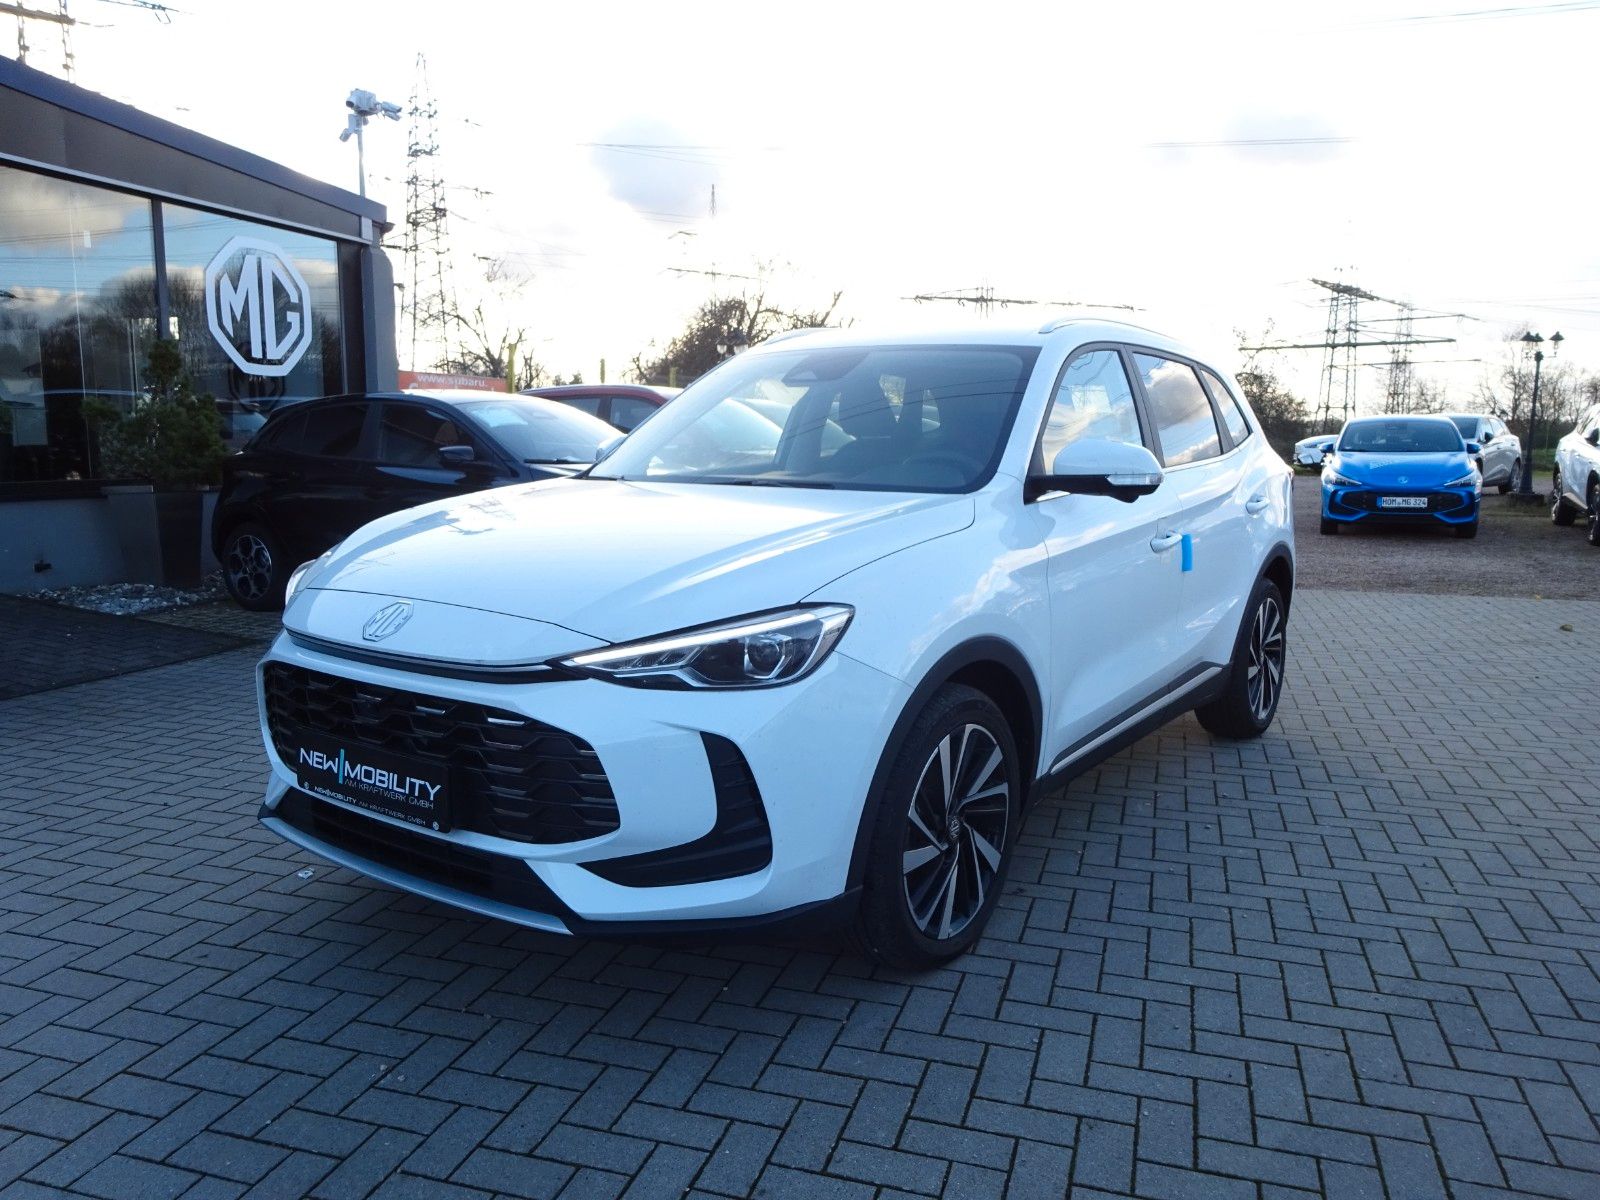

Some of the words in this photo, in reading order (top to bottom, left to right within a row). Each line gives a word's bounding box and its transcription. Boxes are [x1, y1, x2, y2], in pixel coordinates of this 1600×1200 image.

[219, 254, 301, 360] MG
[1401, 498, 1412, 506] MG
[1412, 498, 1427, 506] 324
[365, 603, 411, 638] MG
[344, 760, 442, 801] MOBILITY
[344, 778, 357, 789] AM
[358, 782, 407, 802] KRAFTWERK
[408, 796, 434, 810] GMBH
[369, 804, 406, 819] KRAFTWERK
[407, 814, 427, 826] GMBH
